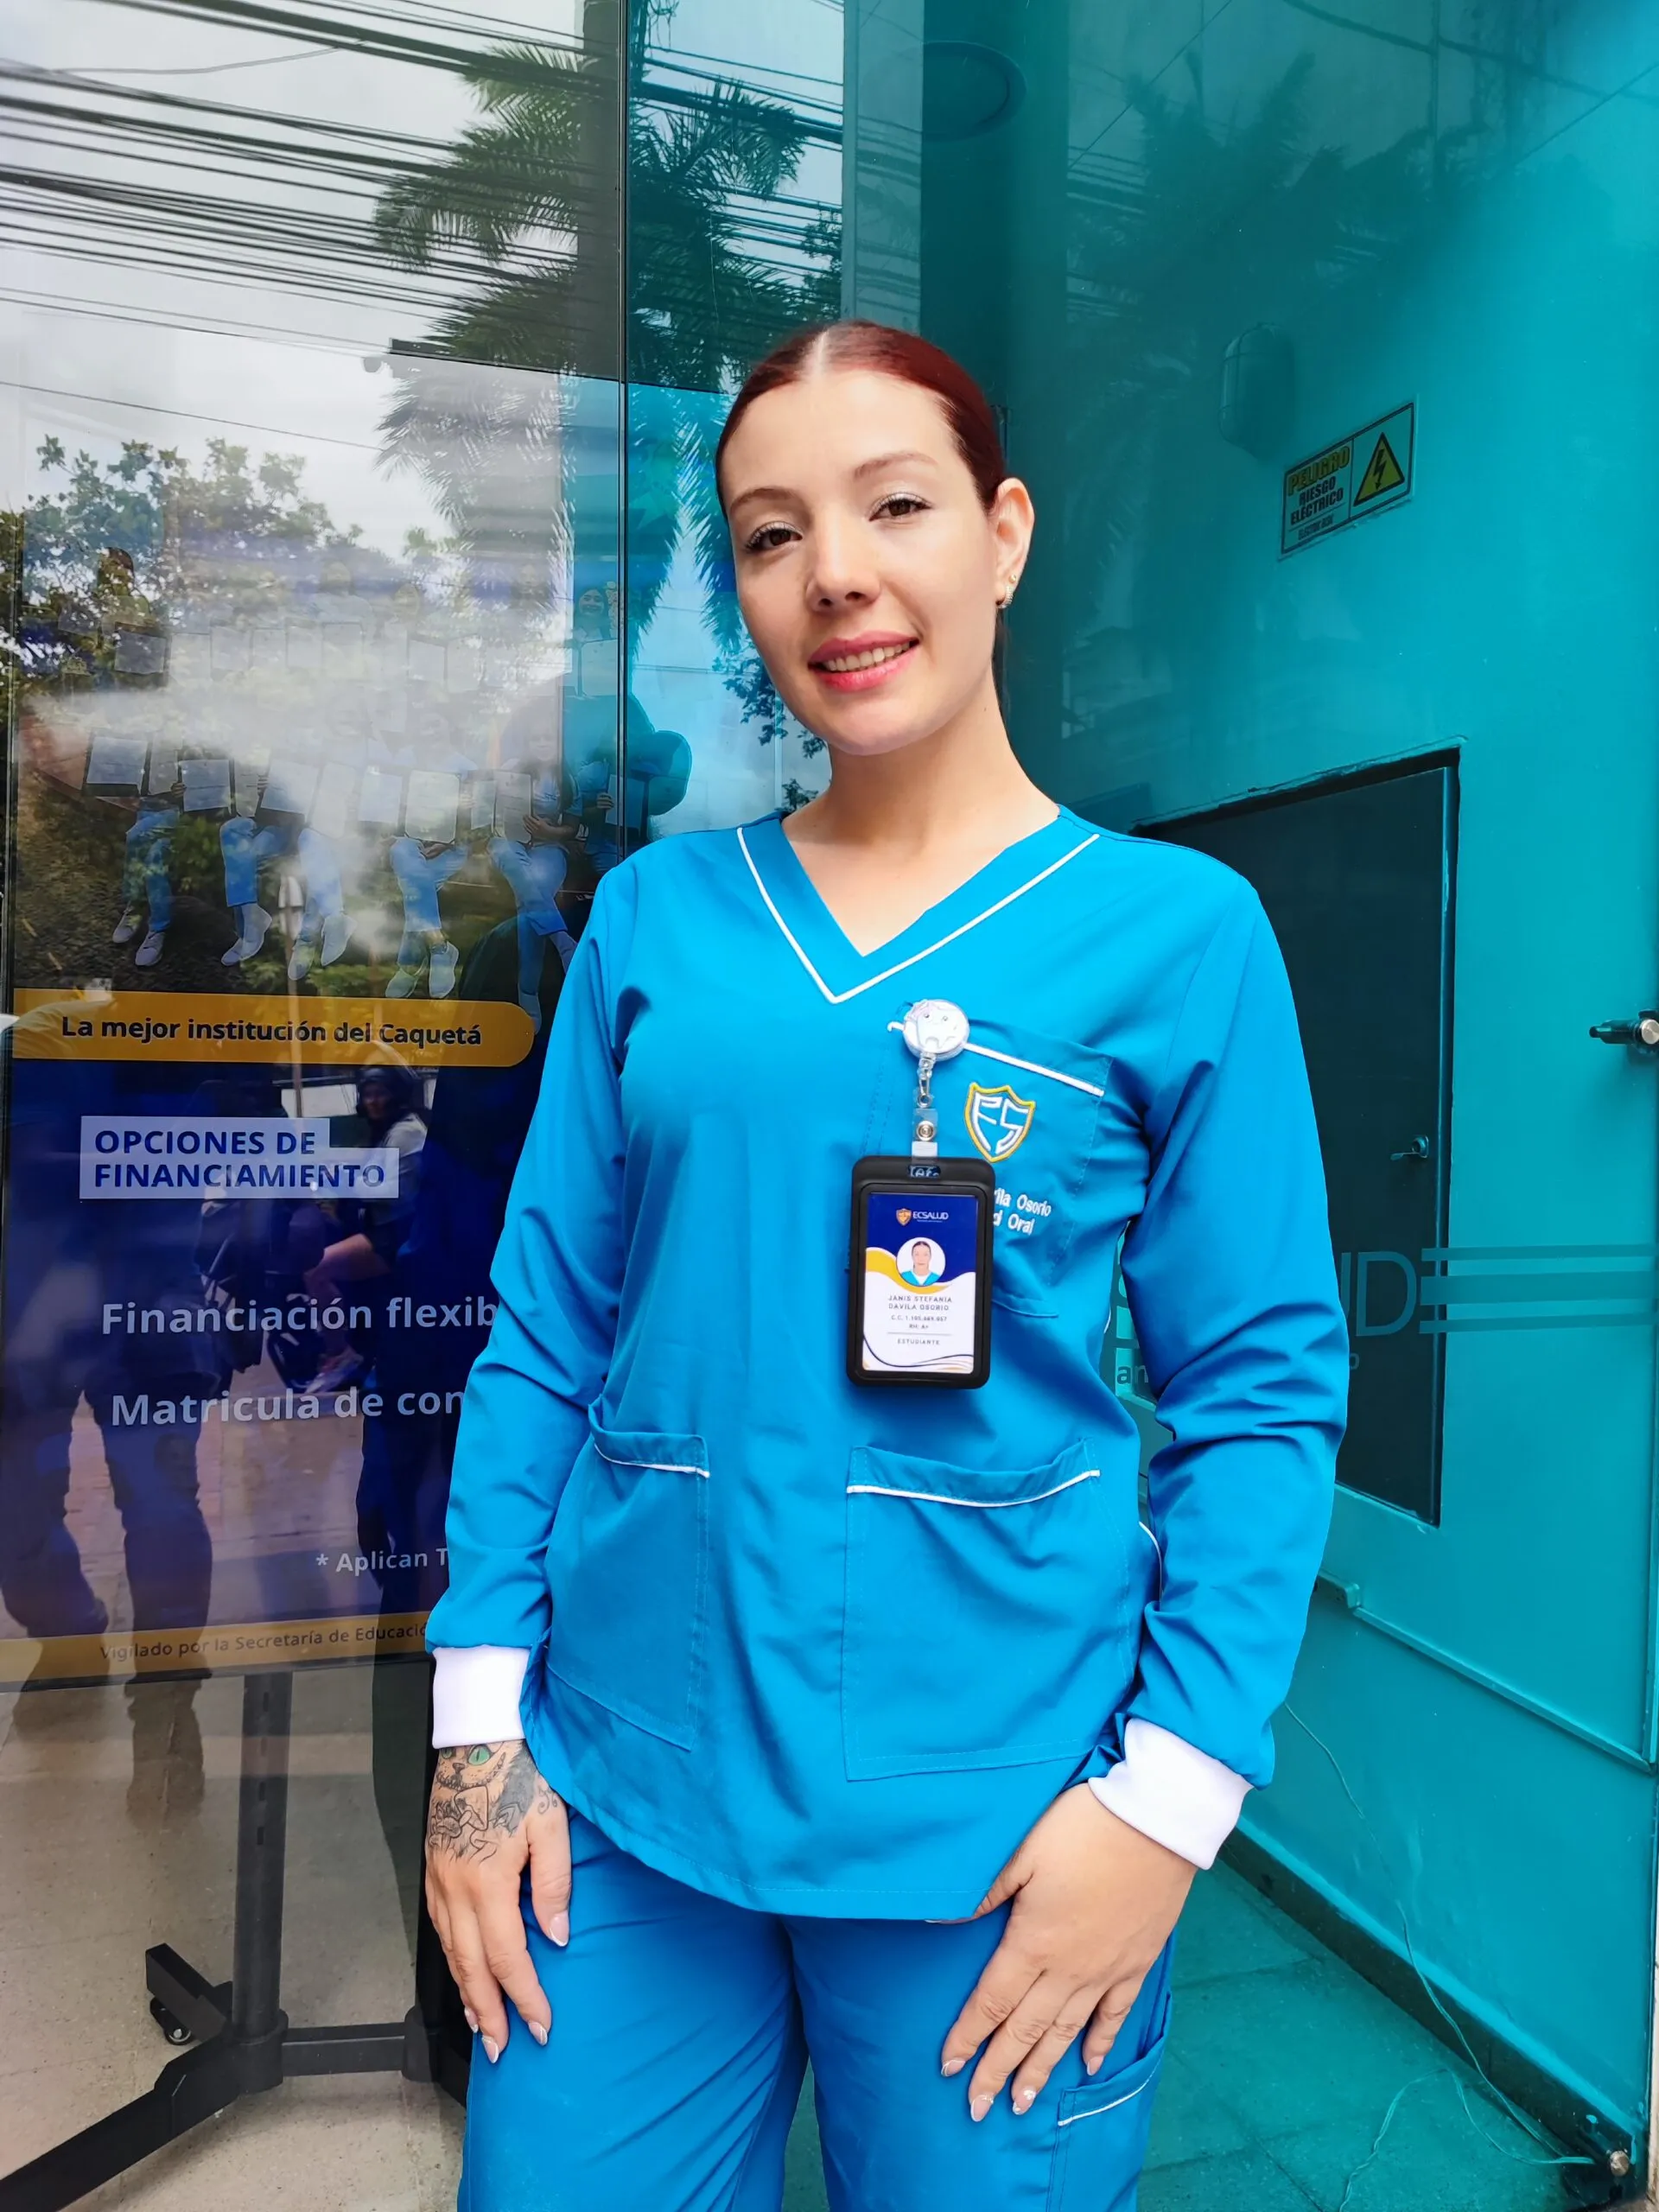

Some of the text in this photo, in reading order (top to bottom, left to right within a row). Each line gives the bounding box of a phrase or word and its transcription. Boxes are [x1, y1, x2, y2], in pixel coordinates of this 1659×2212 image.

[1287, 445, 1351, 496] PELIGRO
[1299, 475, 1336, 506] RIESGO
[62, 1016, 482, 1049] La mejor institución del Caquetá
[94, 1130, 315, 1155] OPCIONES DE
[94, 1164, 385, 1188] FINANCIAMIENTO
[912, 1211, 950, 1220] ECSALUD
[1016, 1194, 1052, 1217] Osorio
[1007, 1212, 1036, 1236] Oral
[102, 1298, 372, 1335] Financiación
[111, 1388, 321, 1426] Matricula
[334, 1387, 384, 1419] de
[335, 1549, 429, 1577] Aplican
[99, 1642, 173, 1662] Vigilado
[179, 1641, 209, 1658] por
[215, 1638, 230, 1652] la
[235, 1630, 323, 1650] Secretaría
[329, 1629, 350, 1643] de
